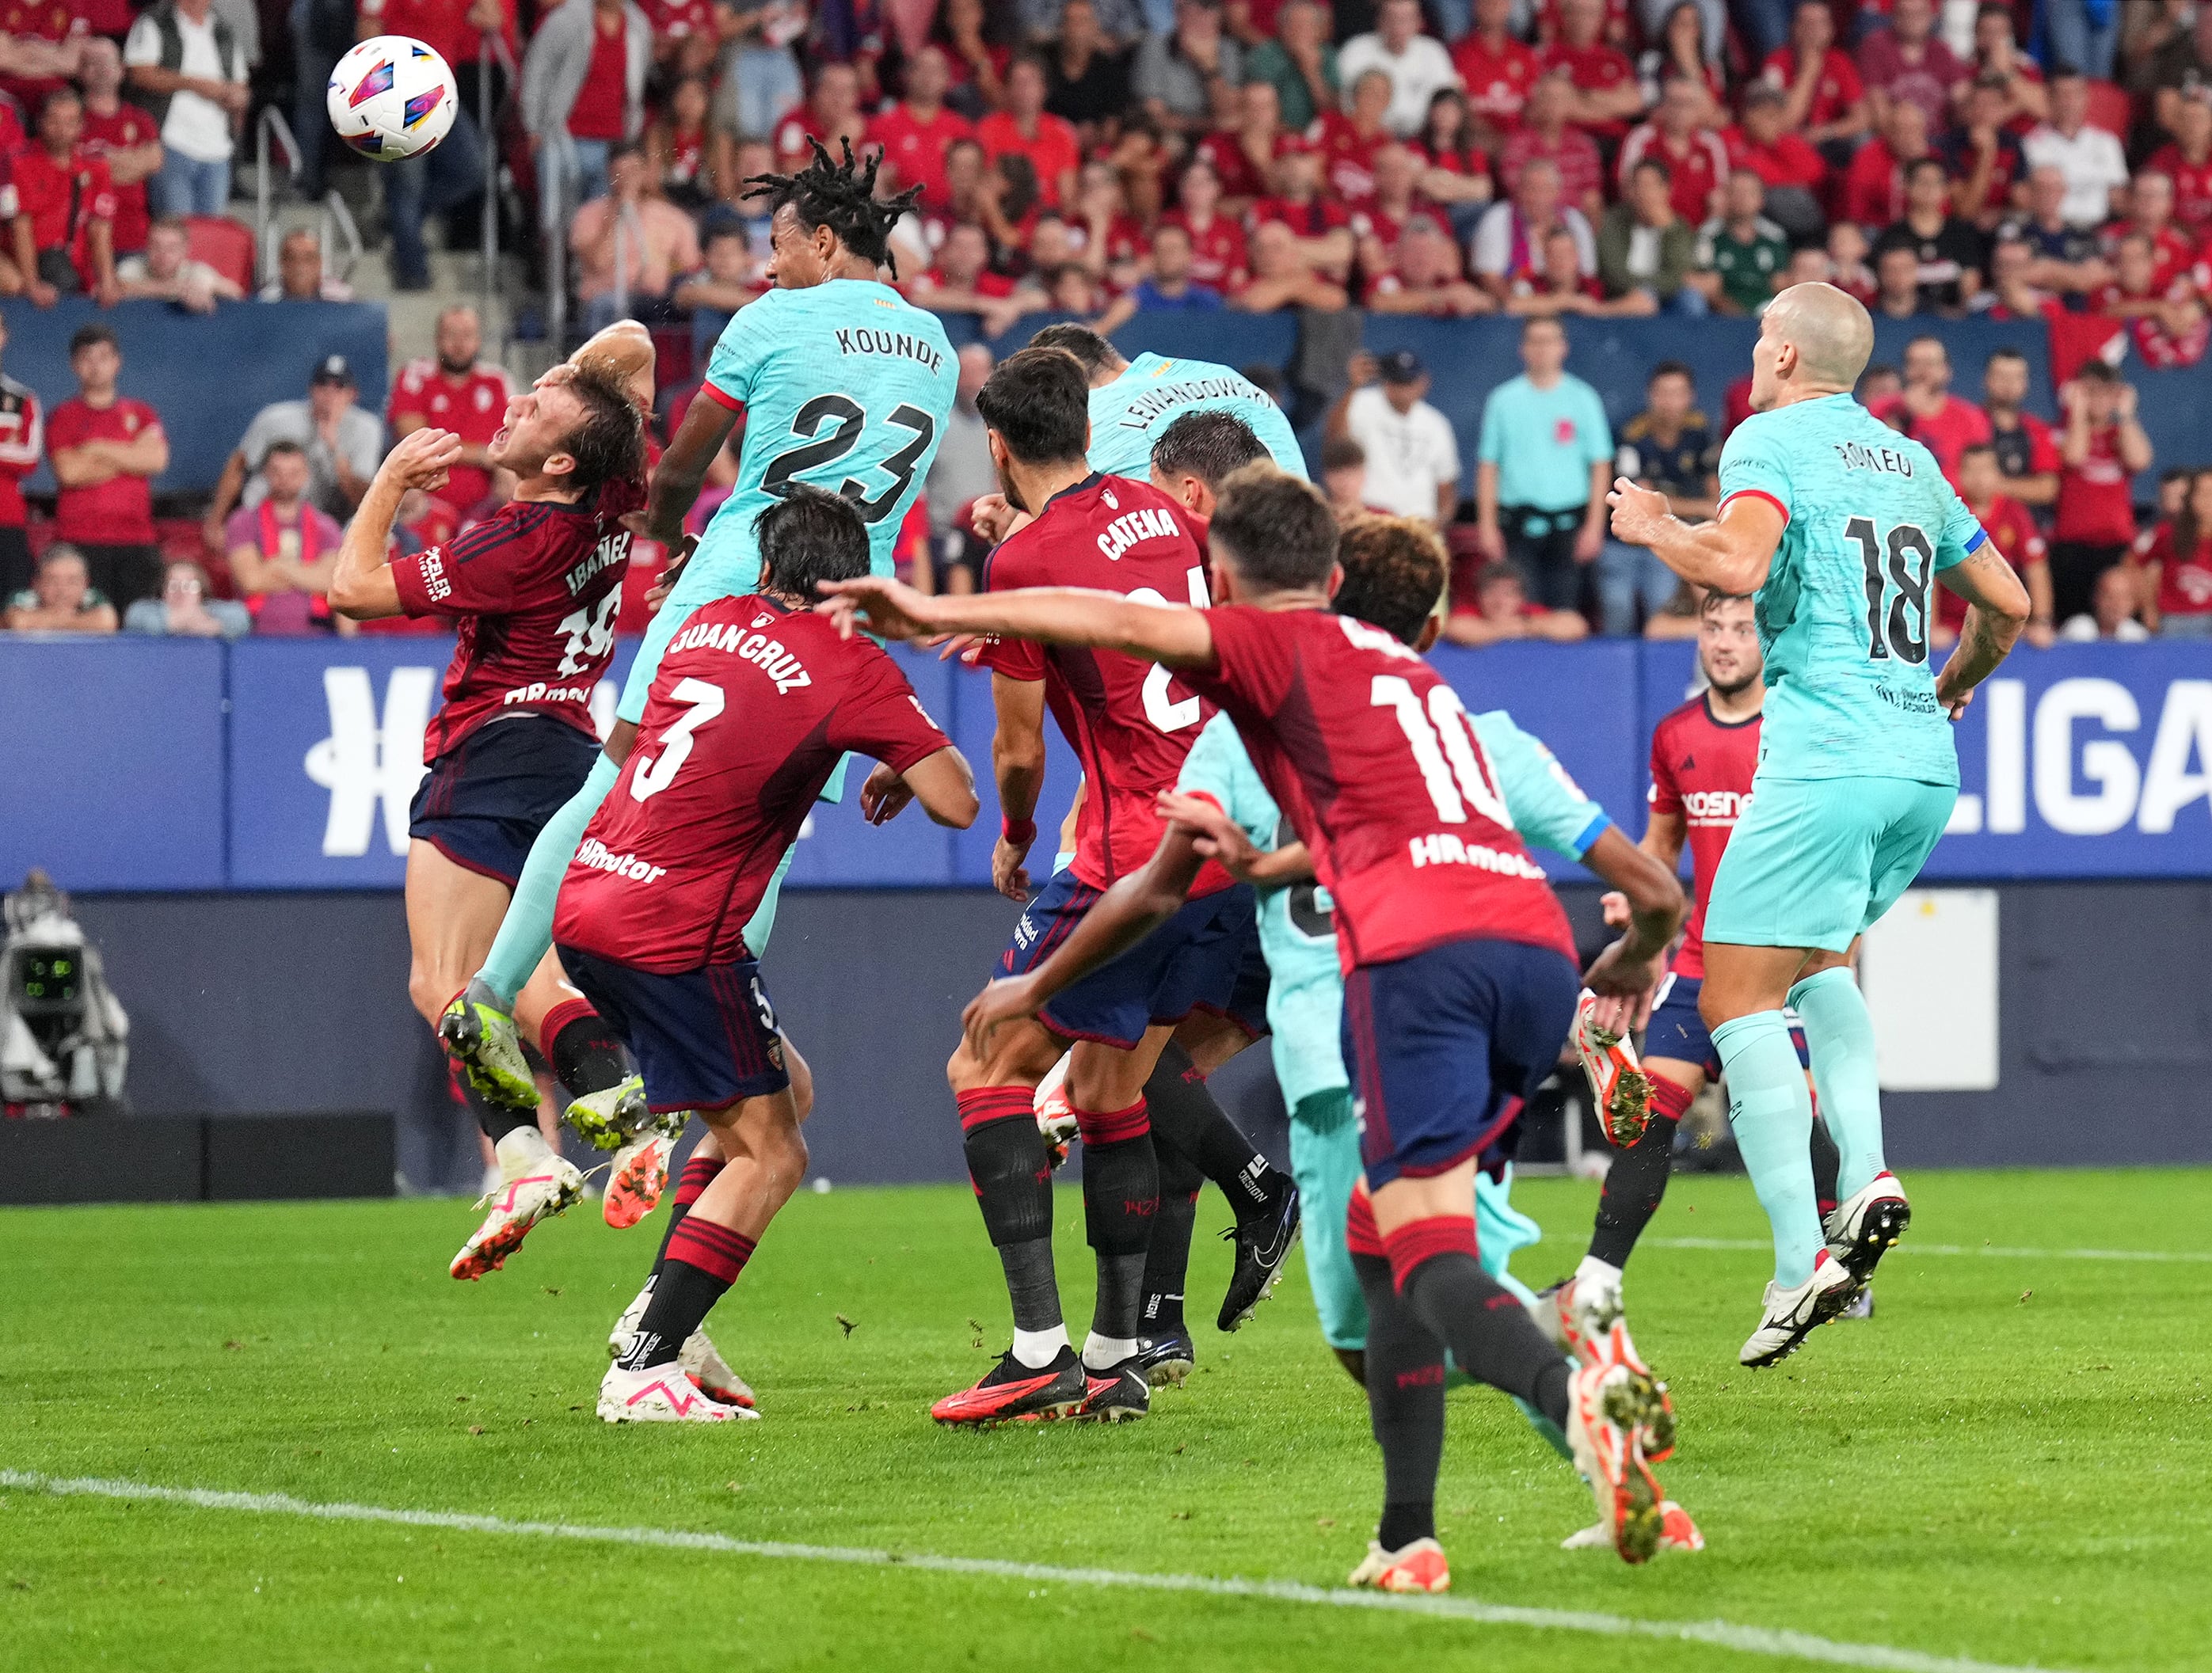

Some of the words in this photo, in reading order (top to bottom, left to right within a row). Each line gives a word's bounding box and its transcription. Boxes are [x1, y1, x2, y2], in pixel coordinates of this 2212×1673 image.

[836, 328, 944, 376] KOUNDE
[760, 393, 935, 526] 23
[1097, 508, 1180, 561] CATENA
[1844, 516, 1933, 665] 18
[669, 622, 748, 654] JUAN
[738, 633, 813, 696] CRUZ
[630, 677, 725, 803] 3
[1369, 674, 1515, 831] 10
[1238, 1169, 1268, 1203] DESIGN
